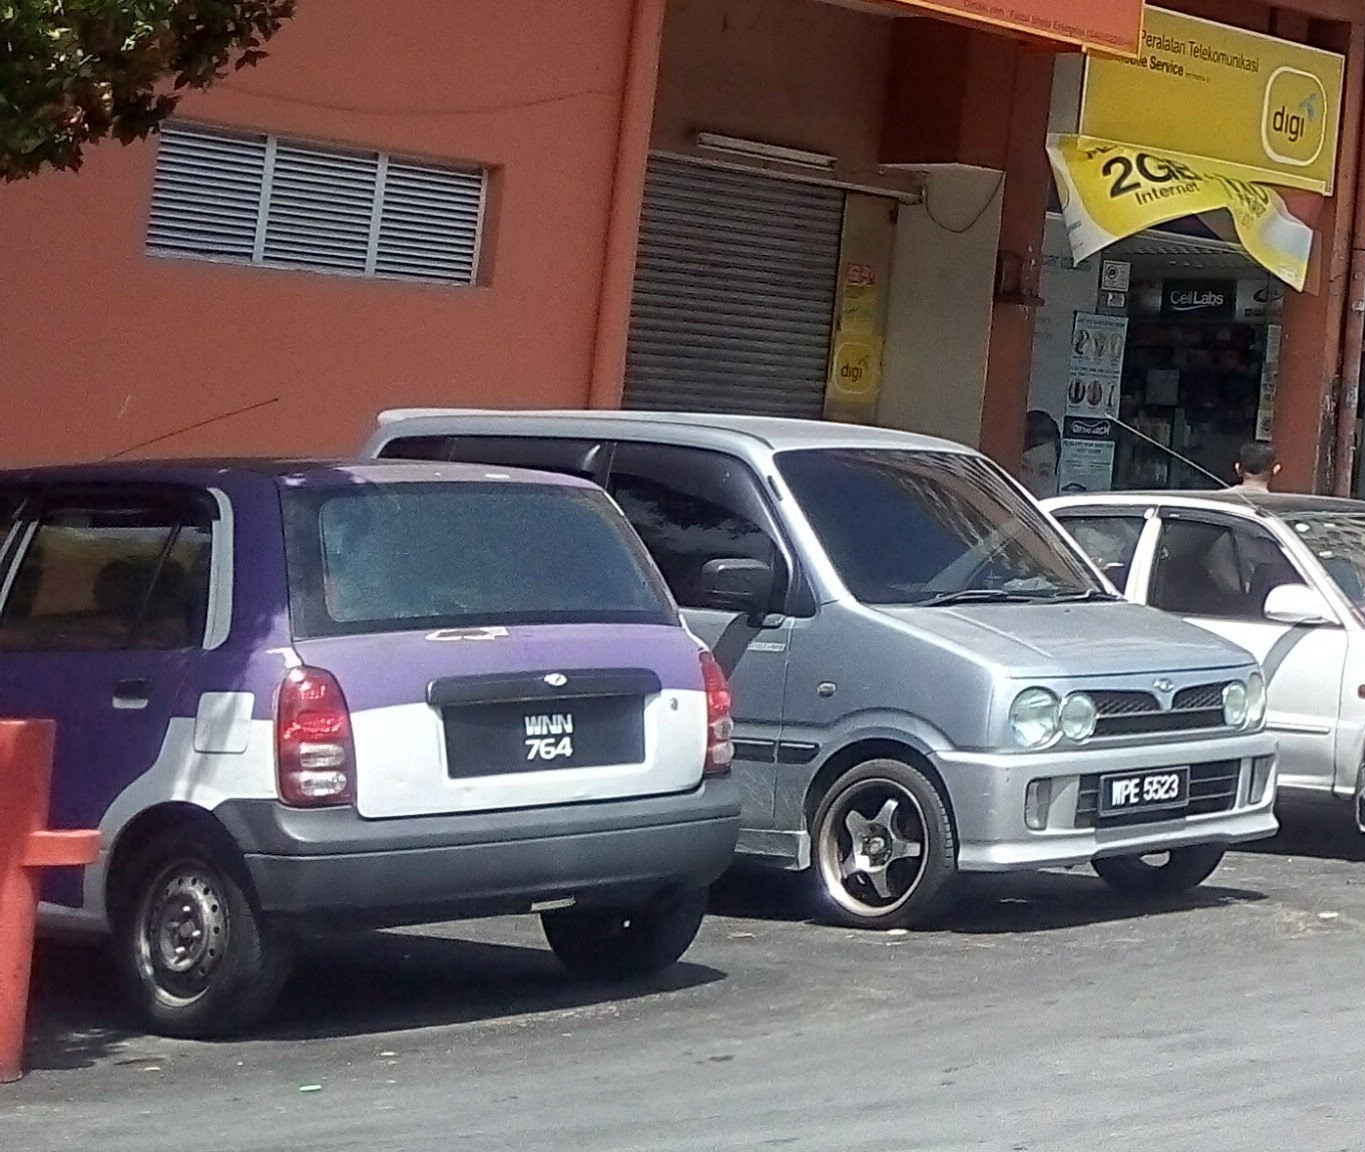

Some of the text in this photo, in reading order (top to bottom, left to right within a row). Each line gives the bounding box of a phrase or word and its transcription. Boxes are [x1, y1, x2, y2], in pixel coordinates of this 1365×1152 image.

[1149, 55, 1184, 77] Service
[1188, 40, 1259, 73] Telekomunikasi
[1273, 106, 1305, 142] digi
[841, 363, 863, 382] digi
[525, 714, 573, 736] WNN
[525, 736, 574, 760] 764
[1112, 774, 1179, 806] WPE 5523
